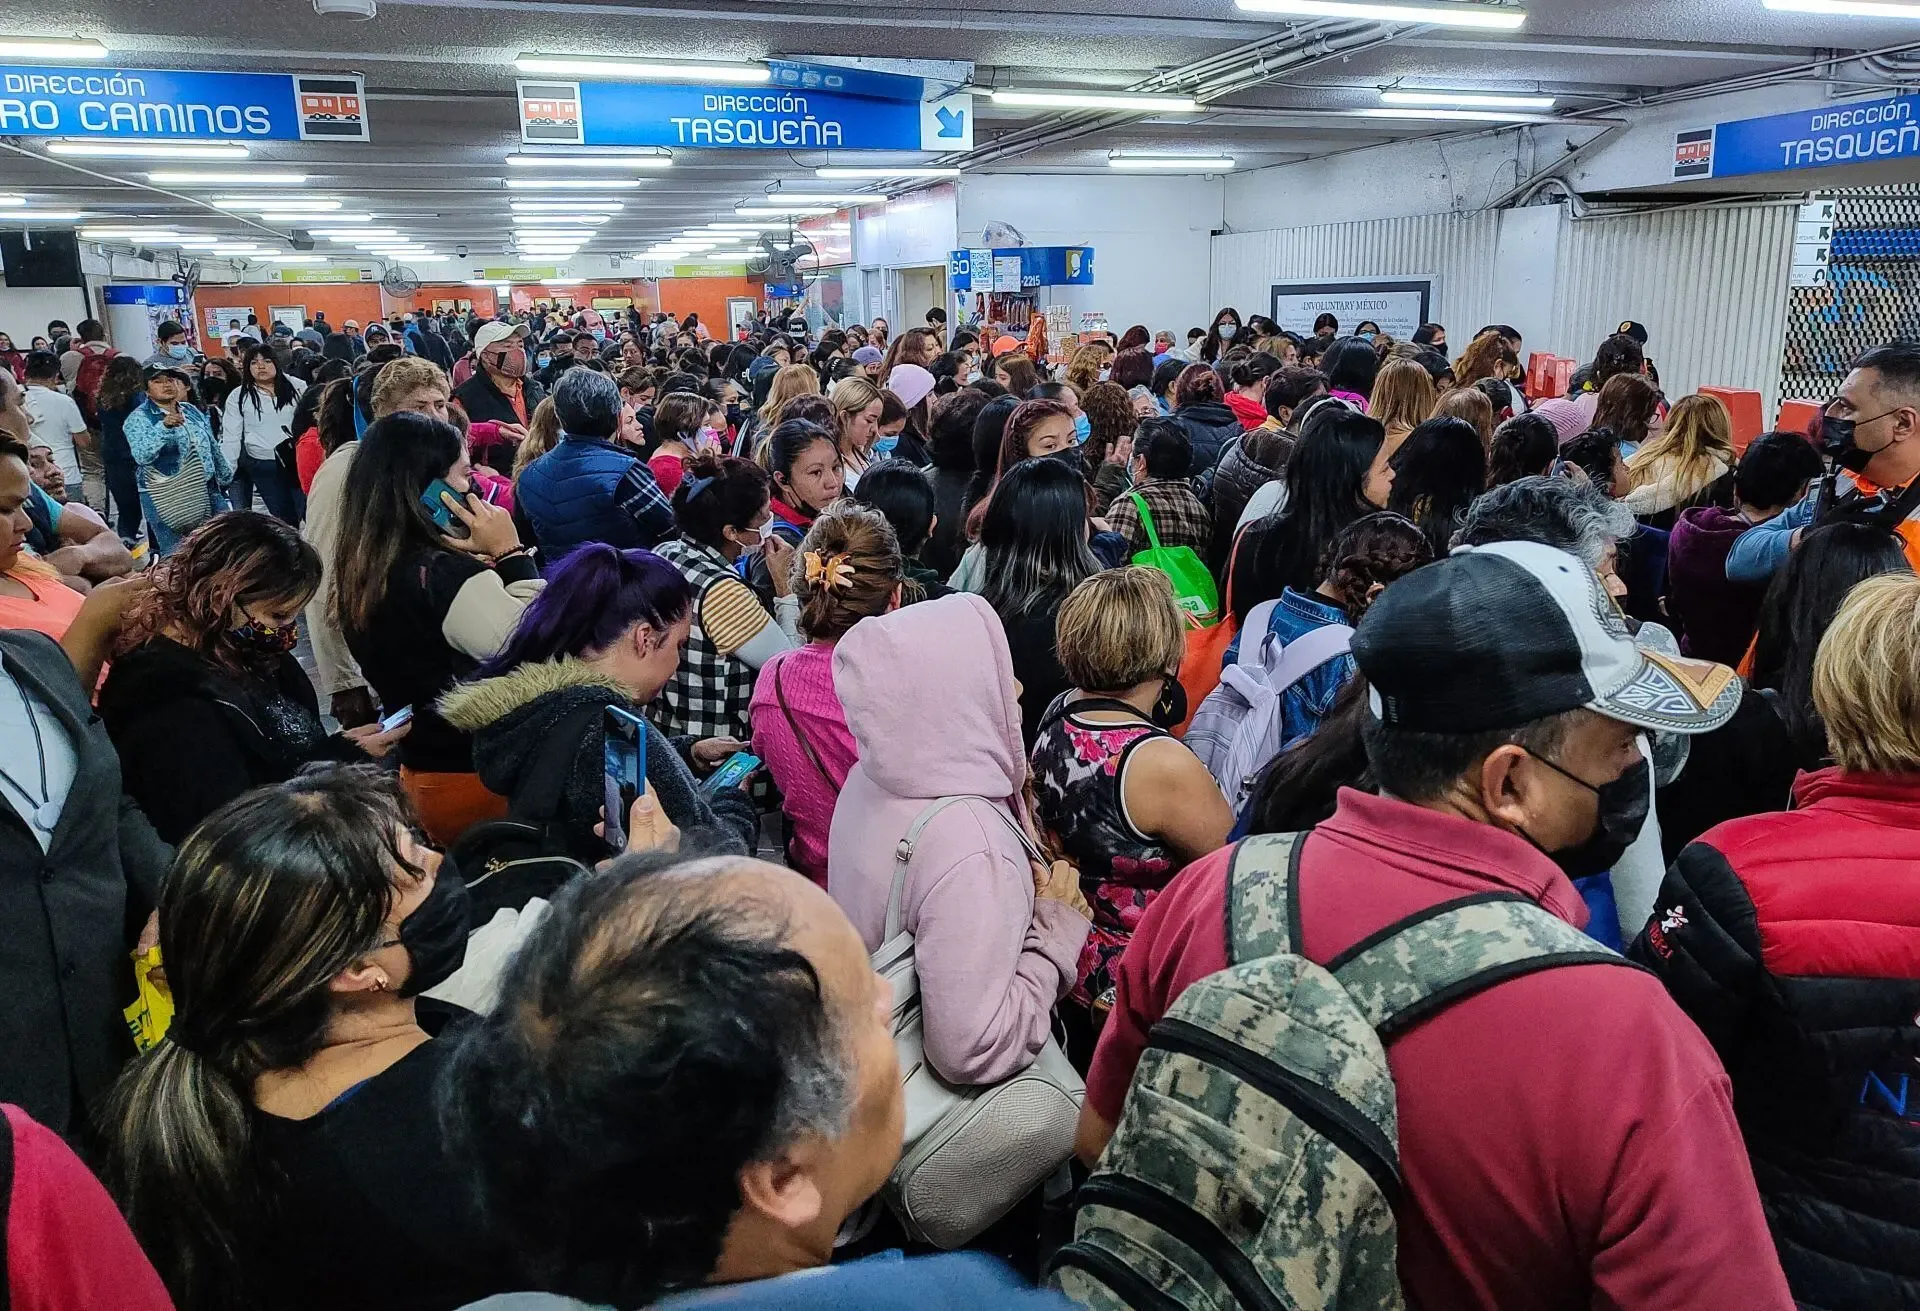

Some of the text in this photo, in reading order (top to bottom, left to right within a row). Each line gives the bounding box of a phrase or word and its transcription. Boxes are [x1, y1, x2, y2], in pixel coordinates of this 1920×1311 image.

[5, 72, 146, 97] DIRECCIÓN
[704, 92, 808, 114] DIRECCIÓN
[1811, 99, 1911, 132] DIRECCIÓN
[80, 101, 272, 135] CAMINOS
[670, 115, 843, 146] TASQUEÑA
[1303, 298, 1388, 311] INVOLUNTARY MÉXICO
